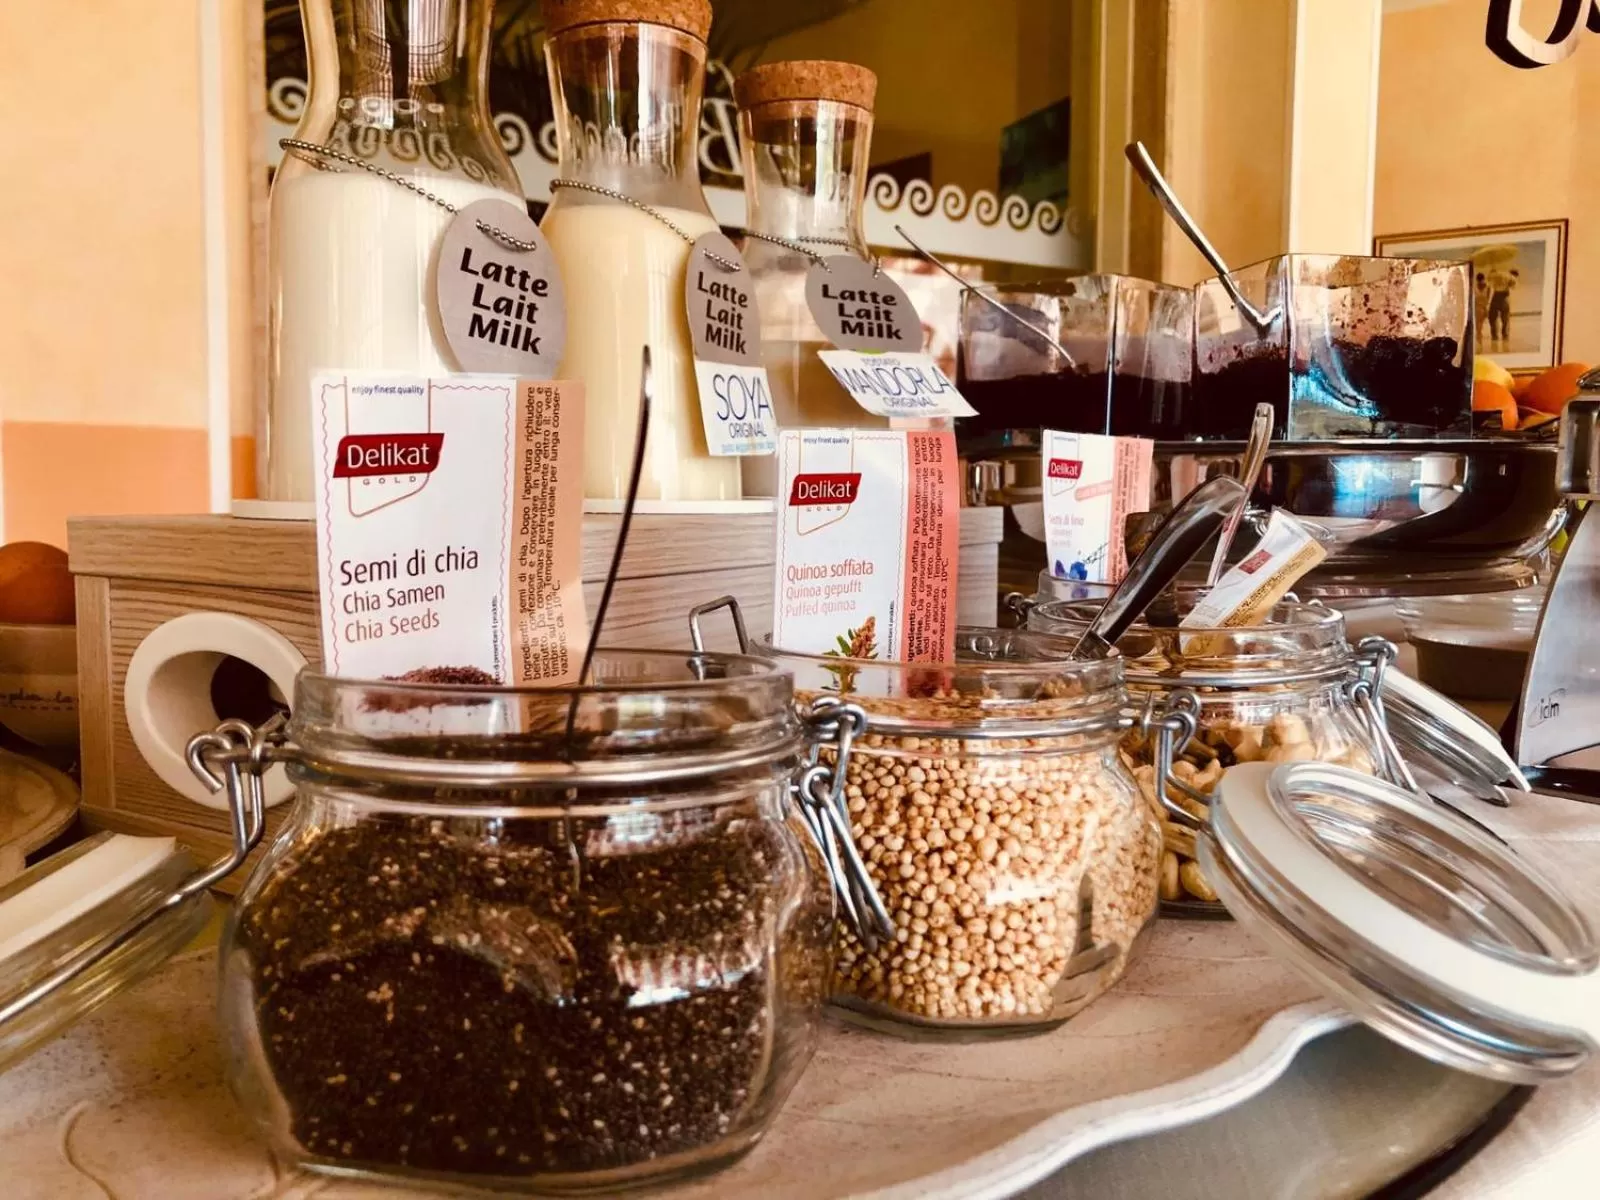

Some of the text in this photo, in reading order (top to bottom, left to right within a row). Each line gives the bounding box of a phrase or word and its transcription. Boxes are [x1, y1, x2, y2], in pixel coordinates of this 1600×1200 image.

[460, 247, 548, 297] Latte
[472, 282, 539, 325] Lait
[697, 271, 748, 309] Latte
[822, 284, 897, 306] Latte
[706, 299, 743, 331] Lait
[838, 303, 893, 323] Lait
[468, 313, 541, 355] Milk
[705, 323, 746, 355] Milk
[841, 319, 903, 341] Milk
[352, 385, 424, 396] enjoy finest quality
[831, 366, 957, 397] MANDORLA
[542, 387, 552, 411] vedi
[551, 387, 561, 429] conser-
[713, 374, 773, 421] SOYA
[882, 397, 938, 408] ORIGINAL
[533, 401, 543, 435] fresco
[729, 422, 768, 439] ORIGINAL
[347, 443, 430, 468] Delikat
[532, 441, 543, 472] luogo
[541, 430, 551, 460] entro
[549, 431, 561, 461] lunga
[928, 437, 936, 462] luogo
[935, 437, 943, 462] lunga
[363, 476, 416, 485] GOLD
[531, 479, 540, 489] in
[548, 465, 558, 482] per
[1050, 461, 1079, 477] Delikat
[538, 463, 550, 545] preferibilmente
[546, 485, 556, 518] ideale
[797, 480, 851, 499] Delikat
[913, 468, 921, 514] contenere
[921, 468, 929, 536] preferibilmente
[518, 387, 535, 682] Ingredienti: semi di chia. Dopo l'apertura richiudere
[529, 496, 539, 554] conservare
[340, 546, 479, 586] Semi di chia
[543, 520, 555, 587] Temperatura
[934, 523, 943, 578] Temperatura
[536, 549, 546, 609] consumarsi
[787, 558, 873, 584] Quinoa soffiata
[919, 543, 927, 592] consumarsi
[343, 584, 445, 614] Chia Samen
[527, 574, 537, 631] confezione
[786, 580, 861, 601] Quinoa gepufft
[910, 577, 918, 606] quinoa
[917, 599, 924, 610] Da
[786, 599, 856, 617] Puffed quinoa
[345, 608, 440, 643] Chia Seeds
[916, 617, 924, 655] glutine.
[530, 637, 540, 648] la
[530, 653, 541, 680] bene
[547, 641, 560, 677] timbro
